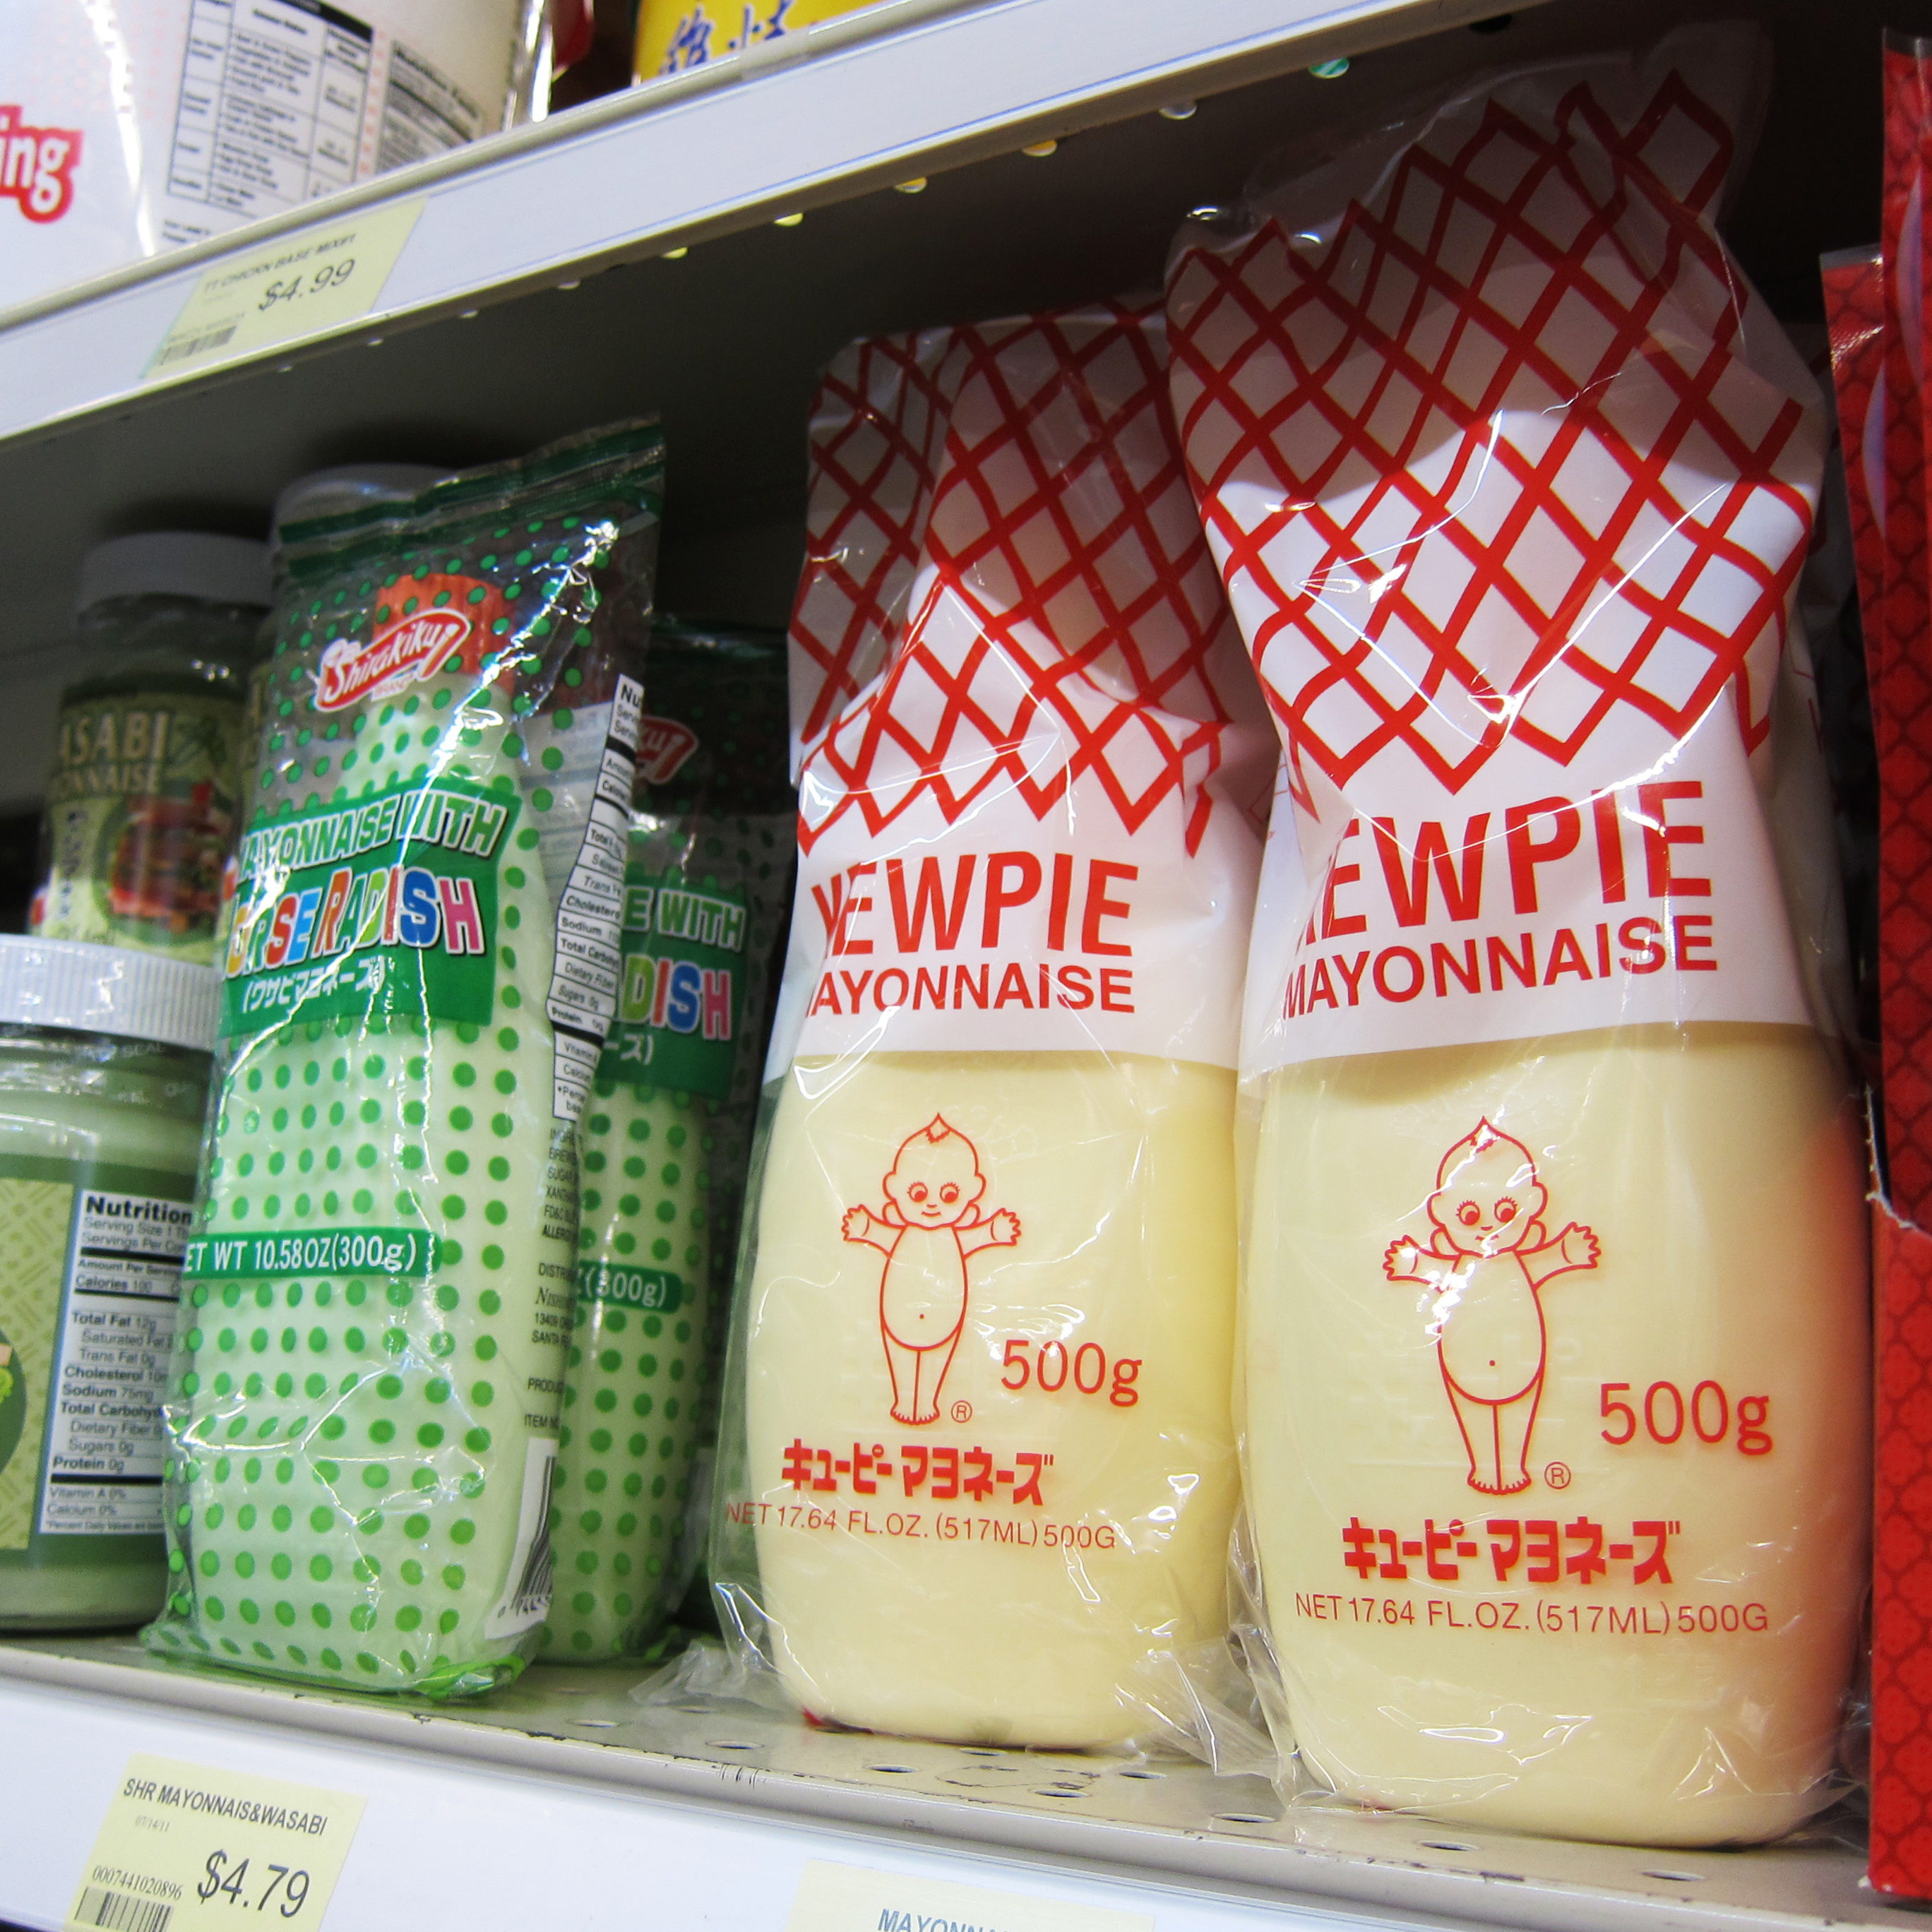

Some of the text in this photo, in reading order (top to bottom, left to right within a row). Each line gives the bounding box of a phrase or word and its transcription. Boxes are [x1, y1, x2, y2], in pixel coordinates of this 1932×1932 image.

[258, 258, 356, 311] $4.99
[321, 619, 460, 703] Shirakiku
[396, 789, 508, 858] WITH
[1296, 780, 1712, 954] EWPIE
[561, 917, 602, 935] Sodium
[657, 888, 746, 952] WITH
[561, 937, 586, 953] Total
[1282, 914, 1718, 1020] MAYONNAISE
[806, 963, 1135, 1018] AYONNAISE
[85, 1195, 192, 1225] Nutrition
[83, 1217, 134, 1235] Serving
[82, 1232, 139, 1251] Servings
[214, 1241, 247, 1271] WT
[254, 1233, 417, 1272] 10.58OZ(300g)
[78, 1258, 124, 1271] Amount
[76, 1275, 128, 1292] Calories
[72, 1311, 106, 1324] Total
[110, 1315, 131, 1327] Fat
[79, 1347, 115, 1362] Trans
[119, 1351, 138, 1364] Fat
[65, 1365, 143, 1381] Cholesterol
[1000, 1339, 1143, 1407] 500g
[63, 1383, 117, 1398] Sodium
[61, 1401, 95, 1414] Total
[1600, 1380, 1773, 1456] 500g
[71, 1421, 117, 1438] Dietary
[121, 1423, 149, 1436] Fiber
[69, 1438, 134, 1457] Sugars 0g
[53, 1455, 124, 1474] Protein 0g
[49, 1486, 94, 1498] Vitamin
[47, 1503, 95, 1515] Calcium
[724, 1501, 772, 1526] NET
[777, 1505, 837, 1532] 17.64
[1295, 1592, 1342, 1621] NET
[1348, 1596, 1414, 1626] 17.64
[124, 1777, 328, 1836] SHR MAYONNAIS&WASABI
[198, 1849, 311, 1919] $4.79
